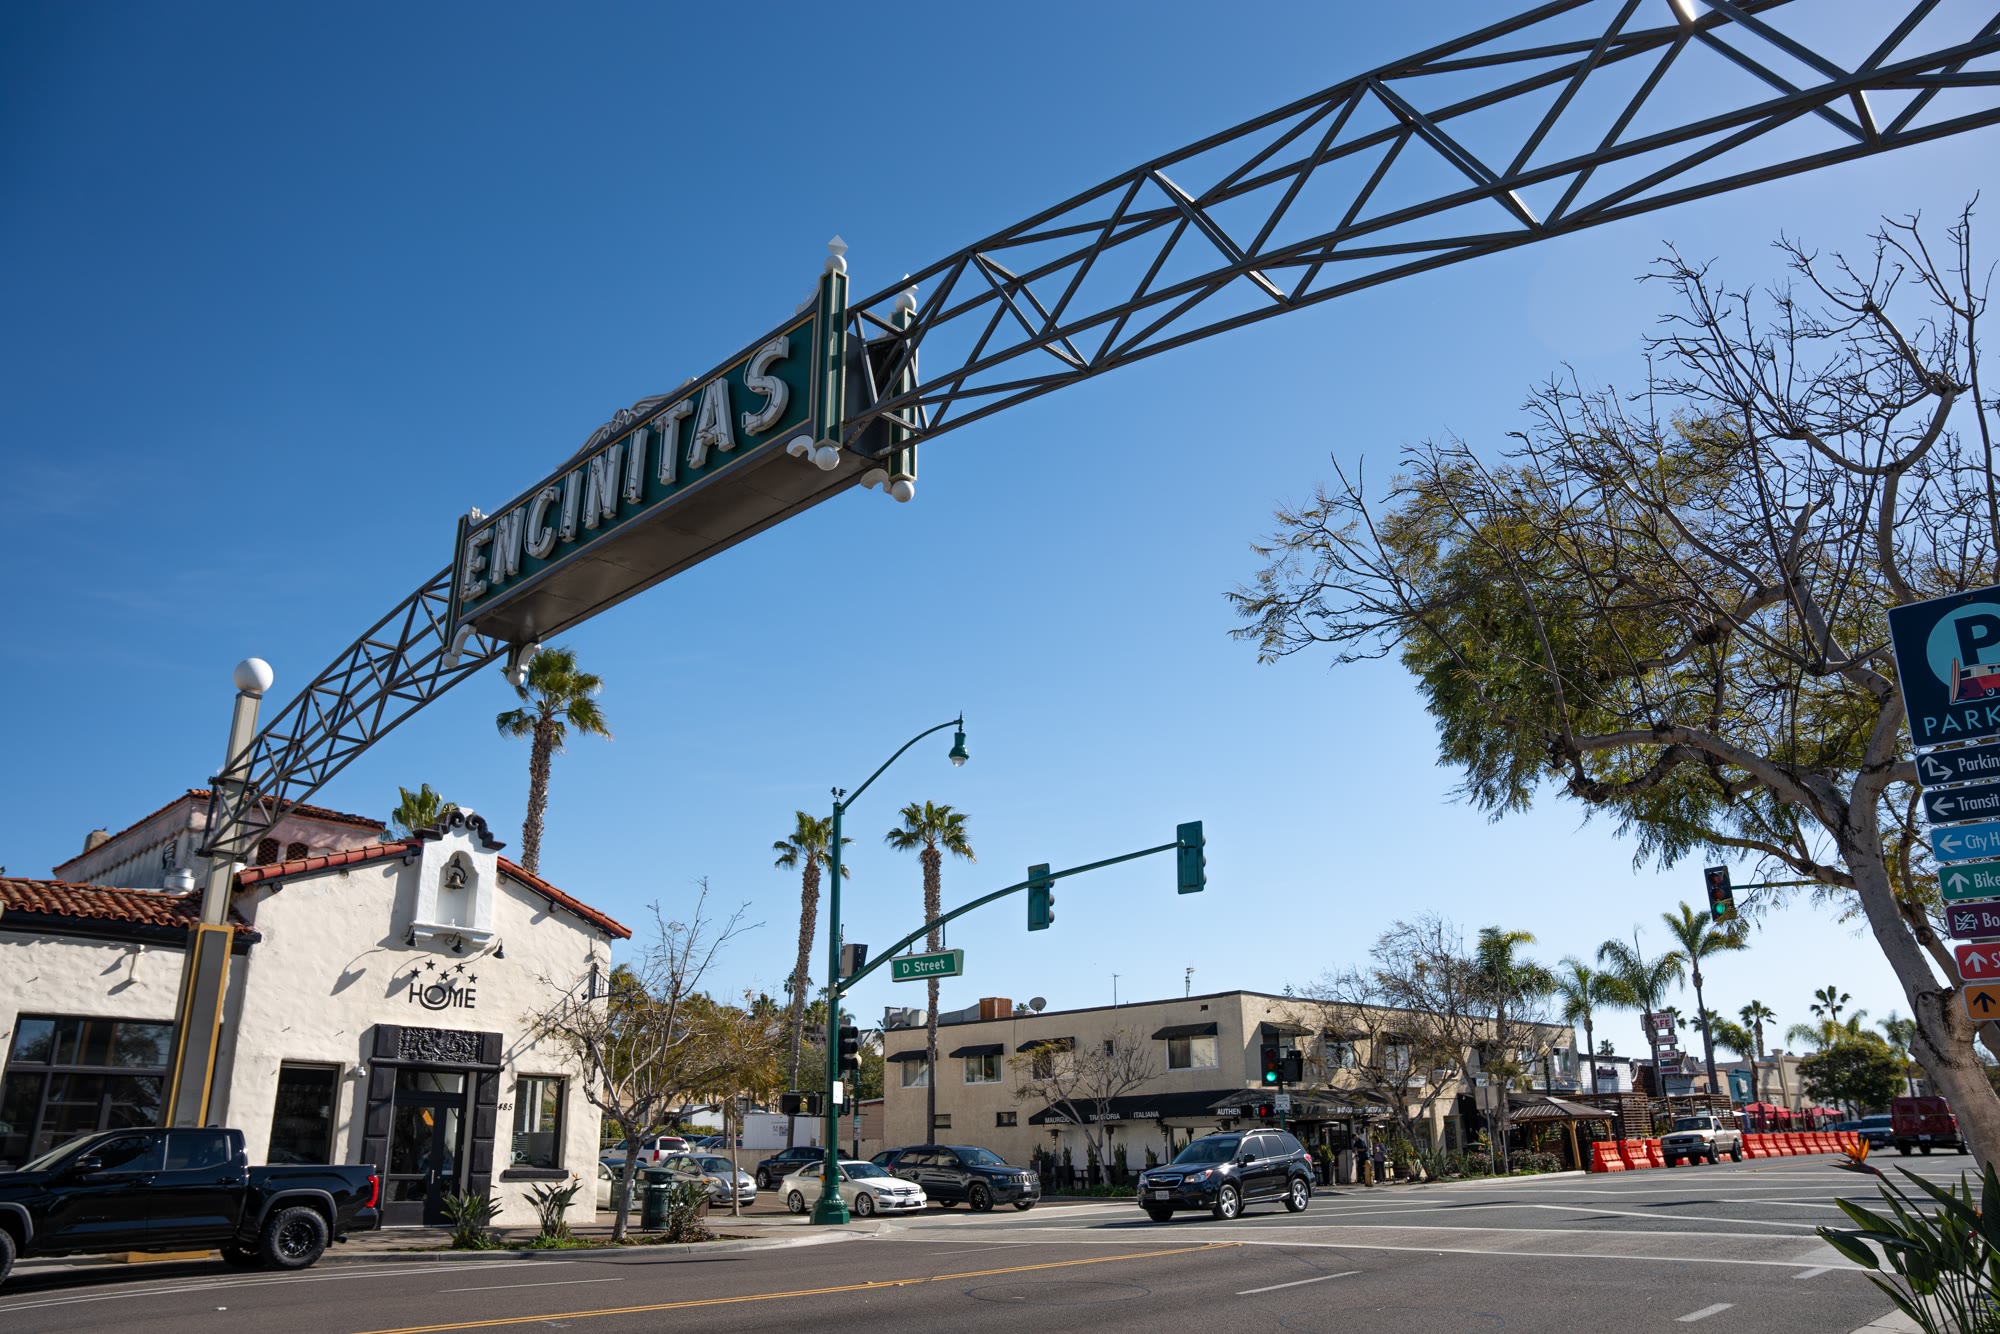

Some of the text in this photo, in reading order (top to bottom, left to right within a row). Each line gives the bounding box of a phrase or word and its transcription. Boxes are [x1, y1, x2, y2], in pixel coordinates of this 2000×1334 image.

[459, 336, 790, 602] ENCINITAS
[1953, 614, 2000, 666] P
[1957, 754, 2000, 772] Parkin
[1956, 793, 2000, 811] Transit
[1965, 834, 1987, 851] City
[902, 959, 945, 974] D Street
[1991, 952, 2000, 968] S
[408, 983, 477, 1010] HOME
[1653, 1019, 1671, 1028] AFE
[497, 1103, 513, 1111] 485
[1133, 1110, 1160, 1118] ITALIANA
[1216, 1107, 1241, 1116] AUTHEN
